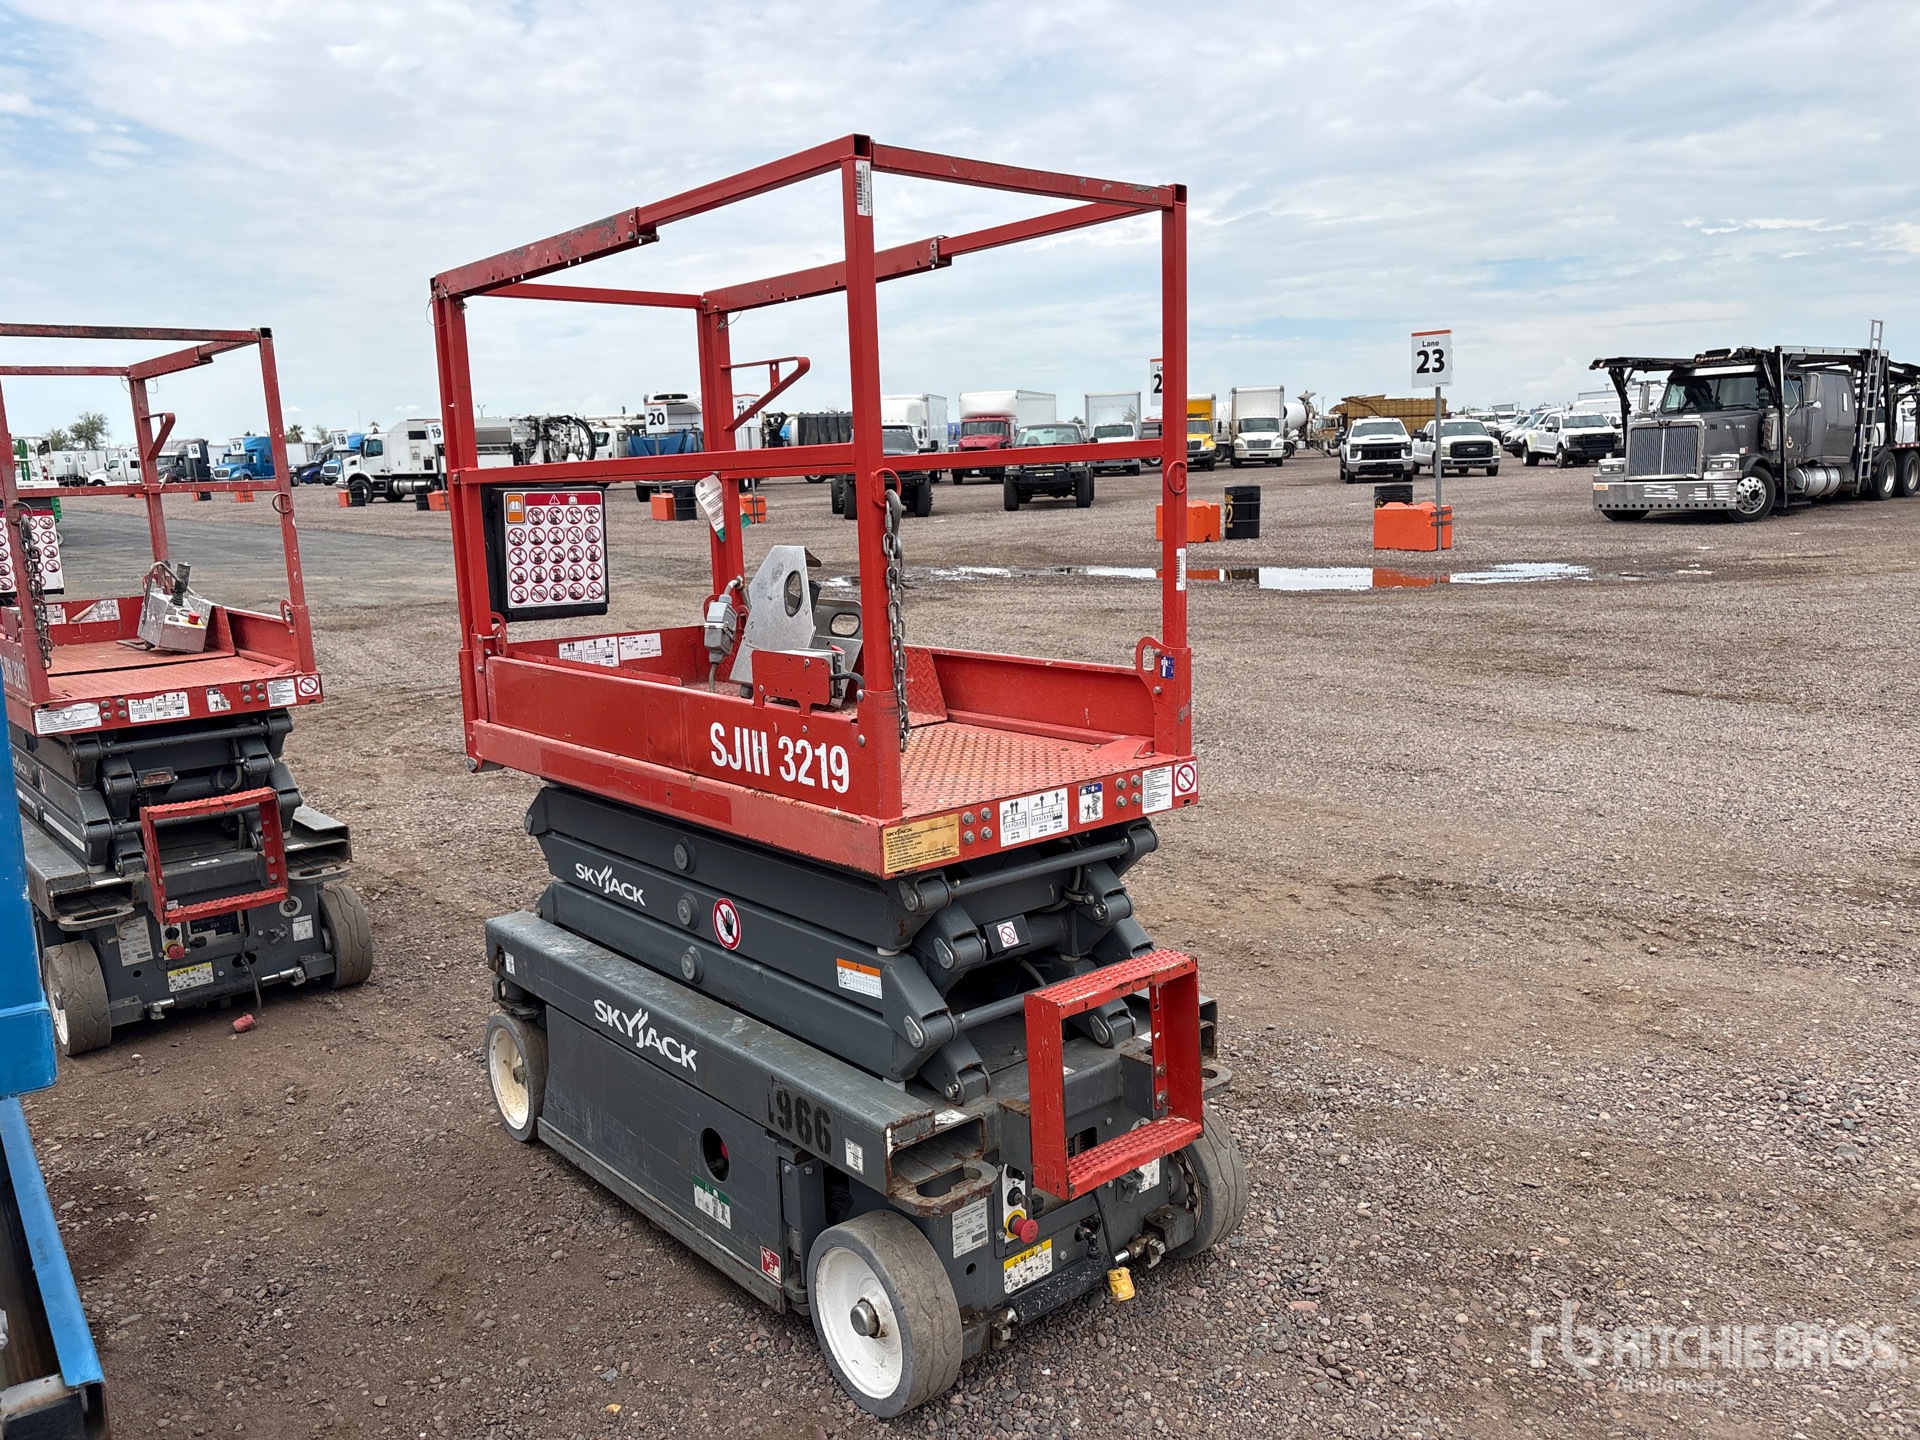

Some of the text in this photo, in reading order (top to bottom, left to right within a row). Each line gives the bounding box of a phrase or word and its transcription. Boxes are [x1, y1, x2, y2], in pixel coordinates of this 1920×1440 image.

[1422, 340, 1440, 348] Lane
[1416, 348, 1445, 374] 23
[1153, 373, 1163, 394] 2
[648, 411, 666, 426] 20
[431, 427, 442, 439] 19
[232, 442, 242, 451] 17
[337, 435, 347, 446] 18
[190, 447, 199, 455] 16
[777, 735, 850, 794] 3219
[886, 827, 913, 837] SKYJACK
[575, 862, 646, 906] SKYJACK
[594, 998, 697, 1072] SKYJACK
